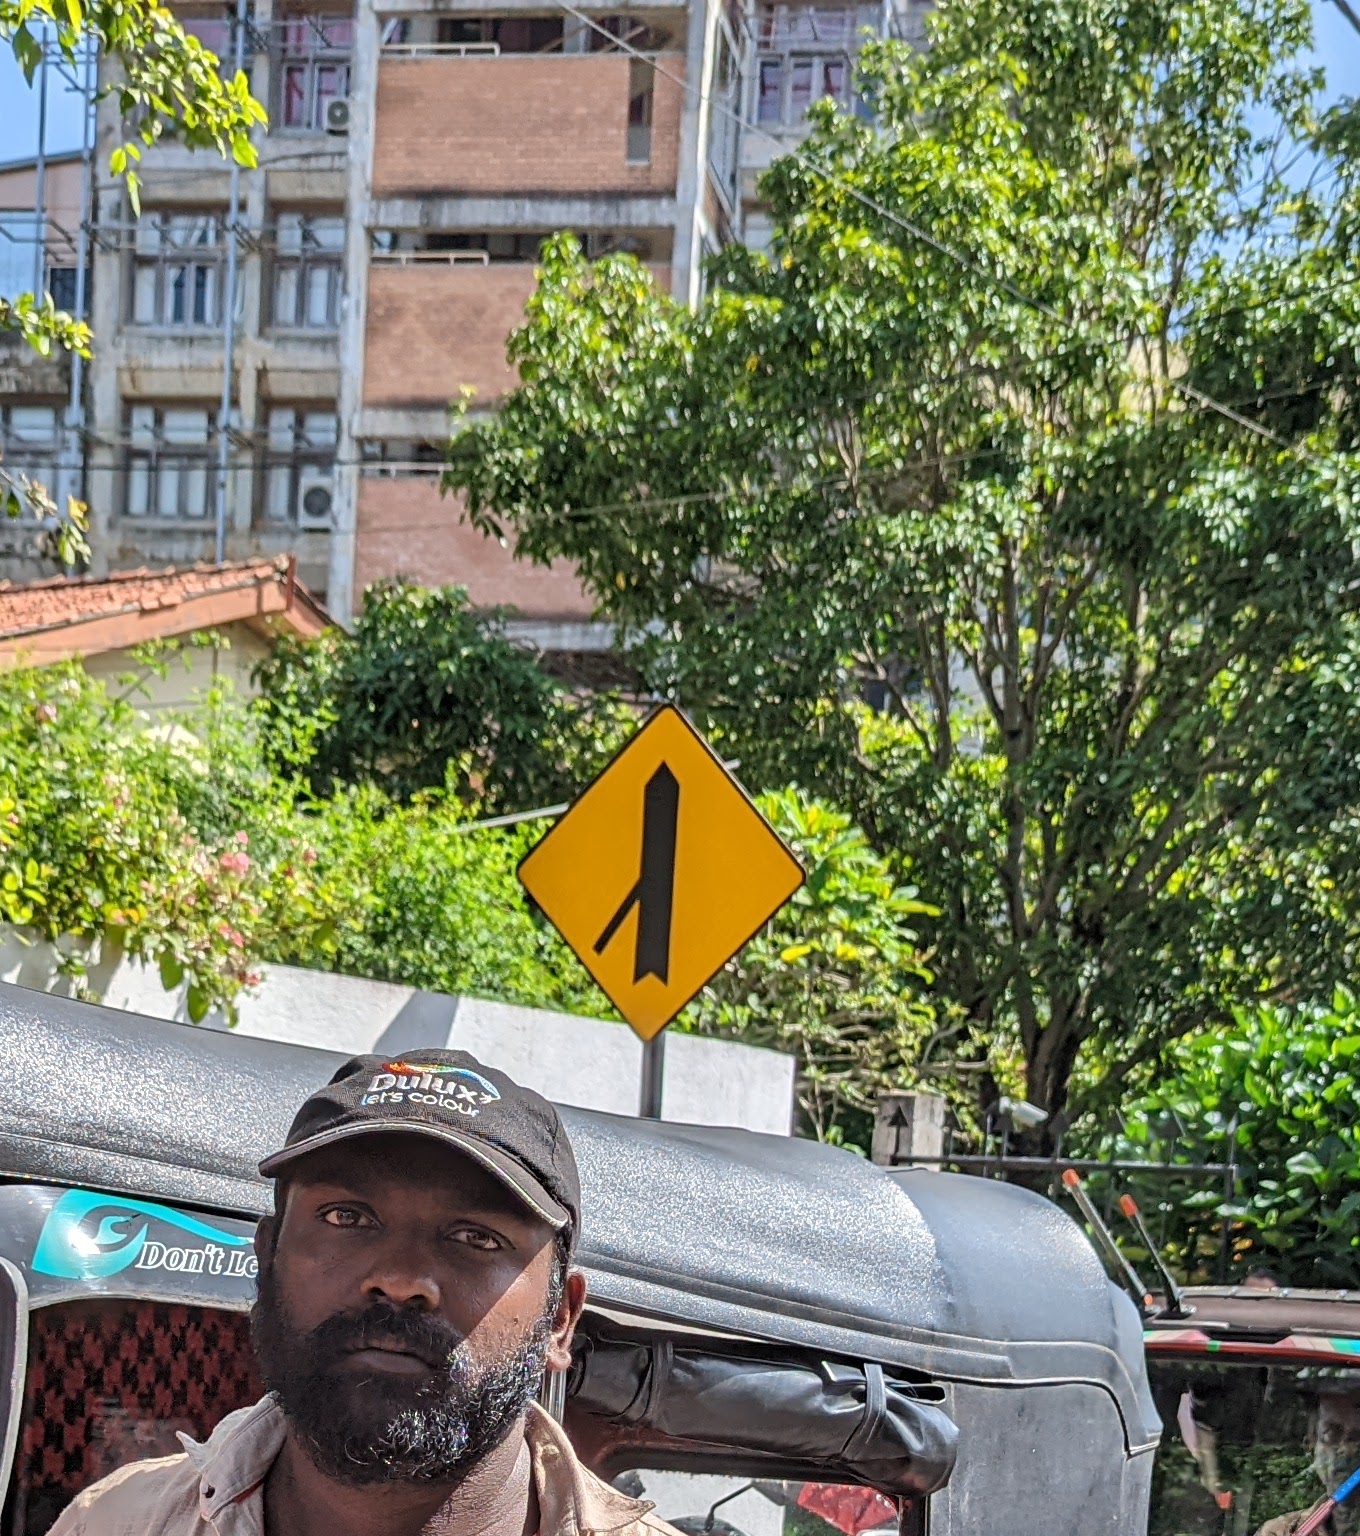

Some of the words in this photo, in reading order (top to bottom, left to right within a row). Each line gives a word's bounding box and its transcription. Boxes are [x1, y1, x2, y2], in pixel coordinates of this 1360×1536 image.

[361, 1091, 404, 1106] let's
[408, 1092, 480, 1118] colour
[367, 1073, 478, 1106] Dulux
[135, 1241, 223, 1275] Don't
